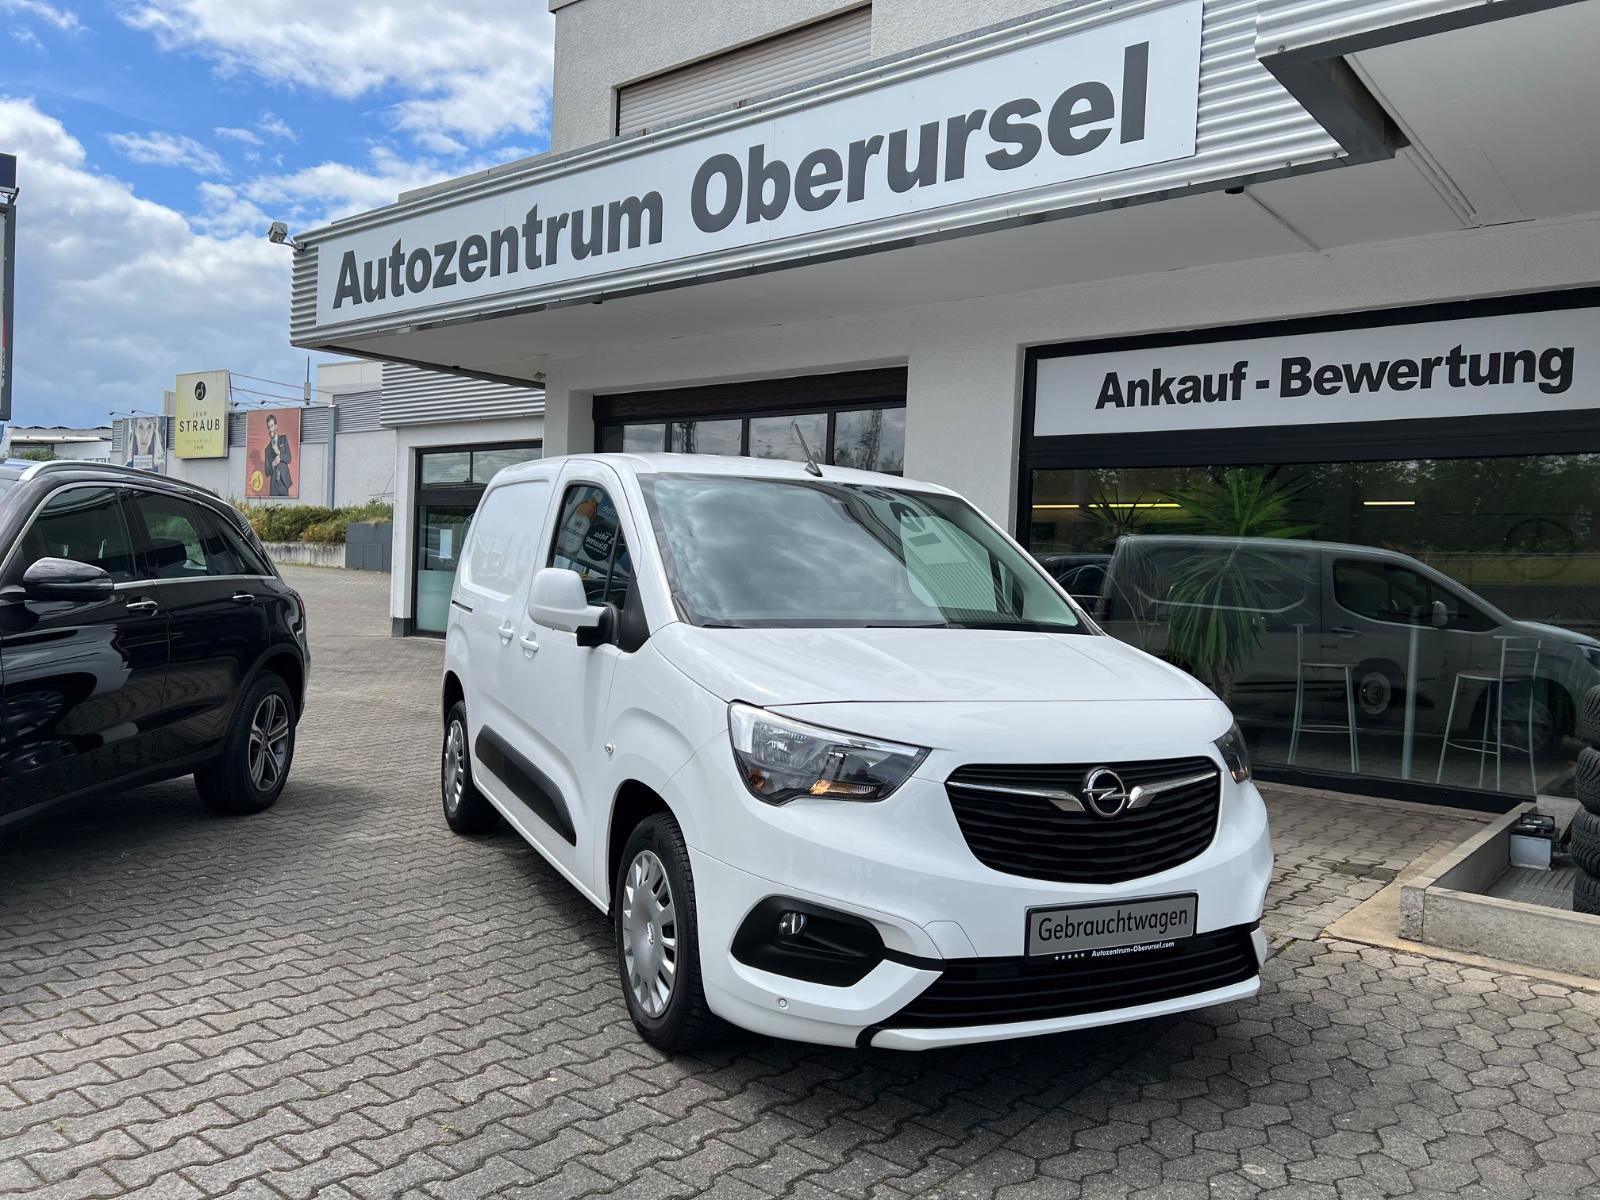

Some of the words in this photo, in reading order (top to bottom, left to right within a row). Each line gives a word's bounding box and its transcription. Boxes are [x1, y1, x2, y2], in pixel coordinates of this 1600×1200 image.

[333, 190, 663, 309] Autozentrum
[690, 41, 1149, 233] Oberursel
[1095, 361, 1248, 409] Ankauf
[1280, 344, 1575, 398] Bewertung
[179, 419, 220, 432] STRAUB
[1038, 909, 1188, 941] Gebrauchtwagen
[1091, 941, 1175, 957] Autozentrum-Oberursel.com
